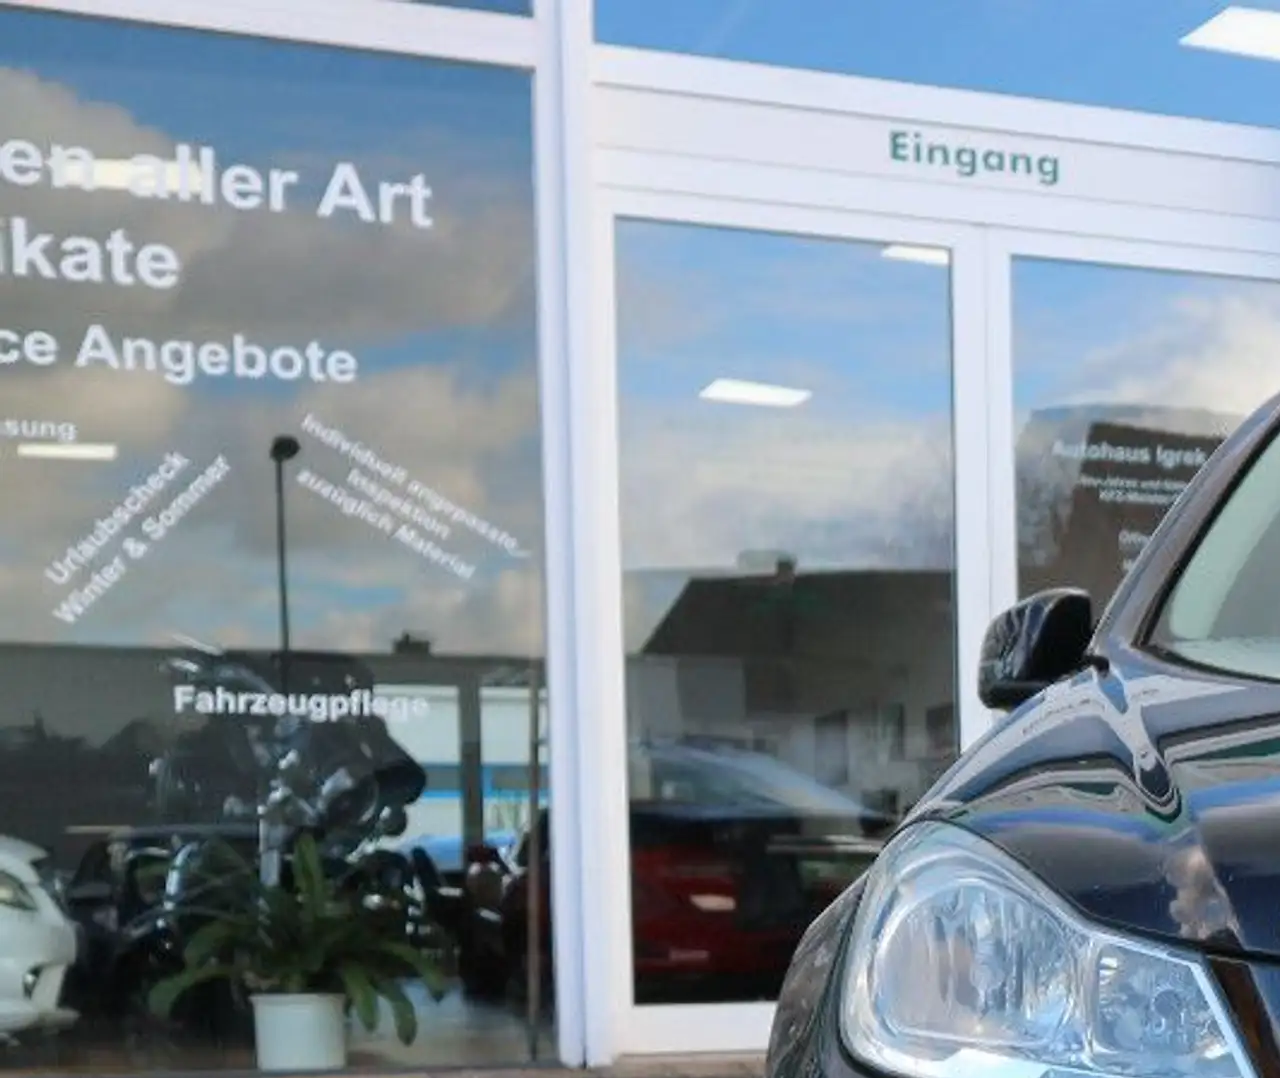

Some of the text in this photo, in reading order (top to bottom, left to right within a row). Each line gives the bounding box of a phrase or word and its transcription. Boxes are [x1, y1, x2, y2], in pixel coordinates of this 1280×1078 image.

[129, 143, 298, 210] aller
[318, 162, 432, 228] Art
[889, 130, 1059, 185] Eingang
[75, 323, 357, 384] Angebote
[1052, 438, 1151, 466] Autohaus
[44, 450, 190, 585] Urlaubscheck
[52, 453, 232, 624] Winter & Sommer
[173, 685, 431, 723] Fahrzeugpflege
